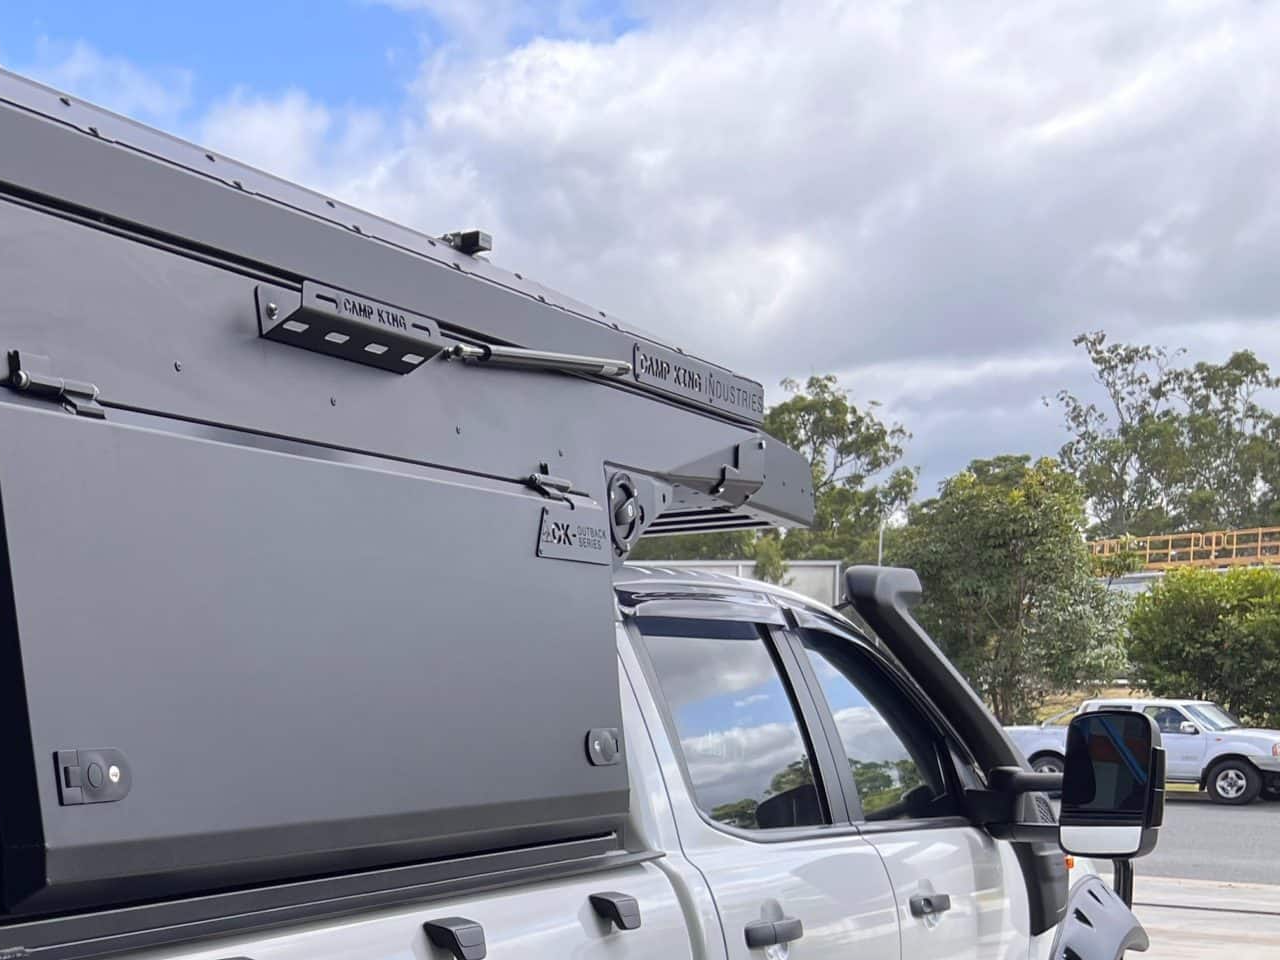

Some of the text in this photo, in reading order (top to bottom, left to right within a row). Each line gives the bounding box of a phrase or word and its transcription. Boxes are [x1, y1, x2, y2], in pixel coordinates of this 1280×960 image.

[343, 297, 408, 332] CAMP KING
[640, 352, 764, 414] CAMP KING INDUSTRIES
